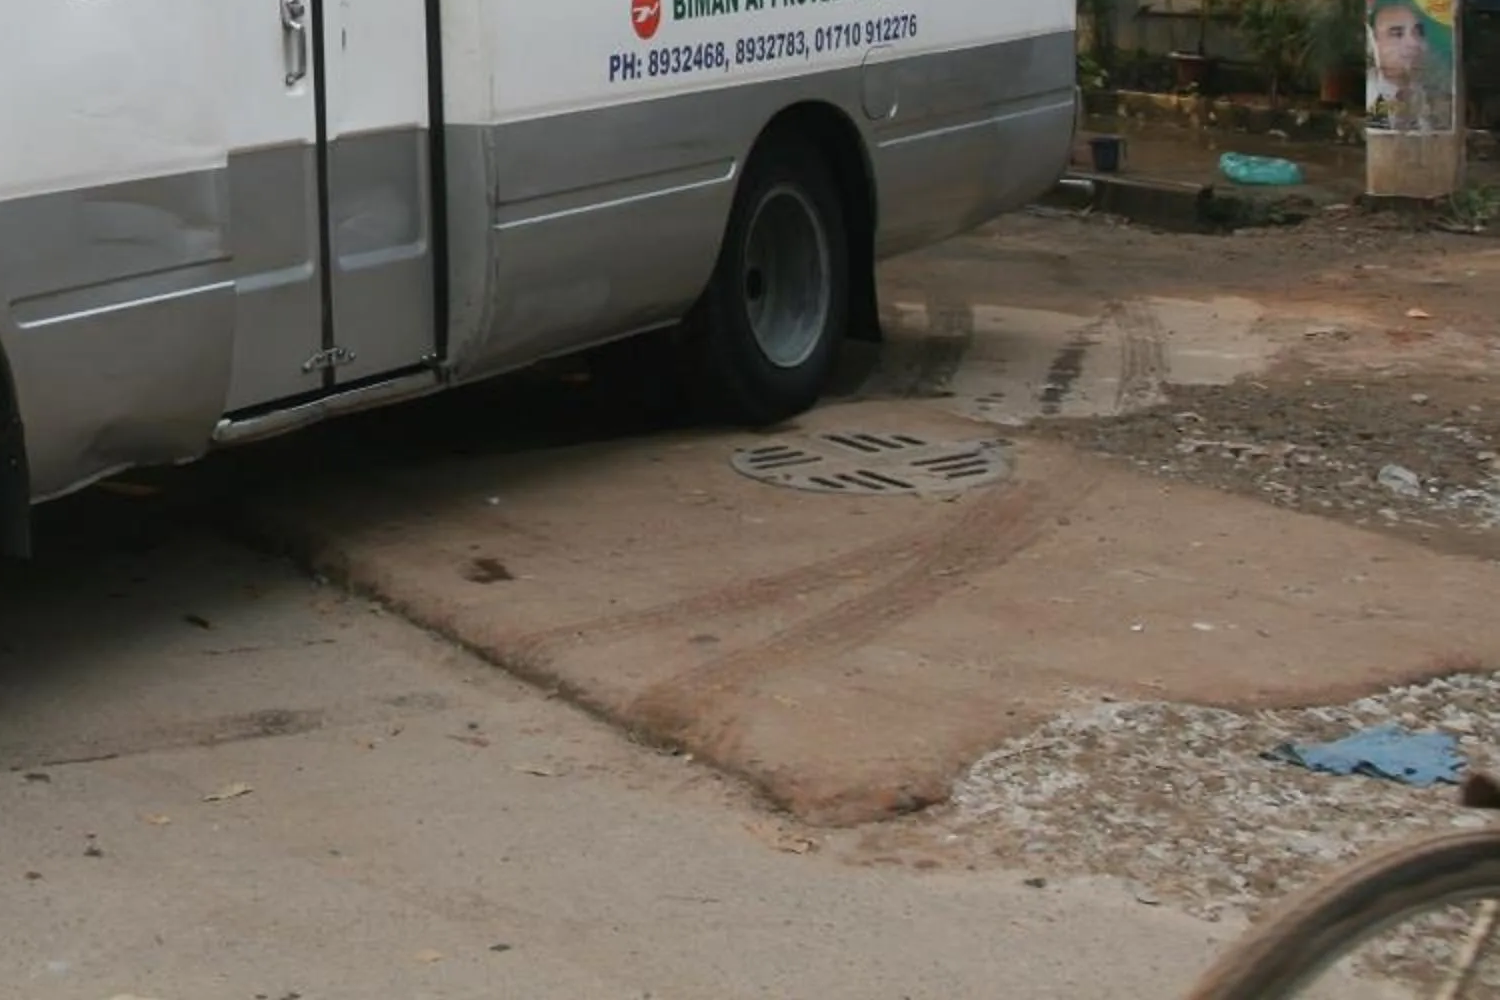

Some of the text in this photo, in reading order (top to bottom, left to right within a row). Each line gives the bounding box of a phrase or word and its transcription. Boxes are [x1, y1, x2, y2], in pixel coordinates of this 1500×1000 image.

[608, 52, 642, 83] PH:
[648, 41, 730, 77] 8932468,
[735, 30, 810, 65] 8932783,
